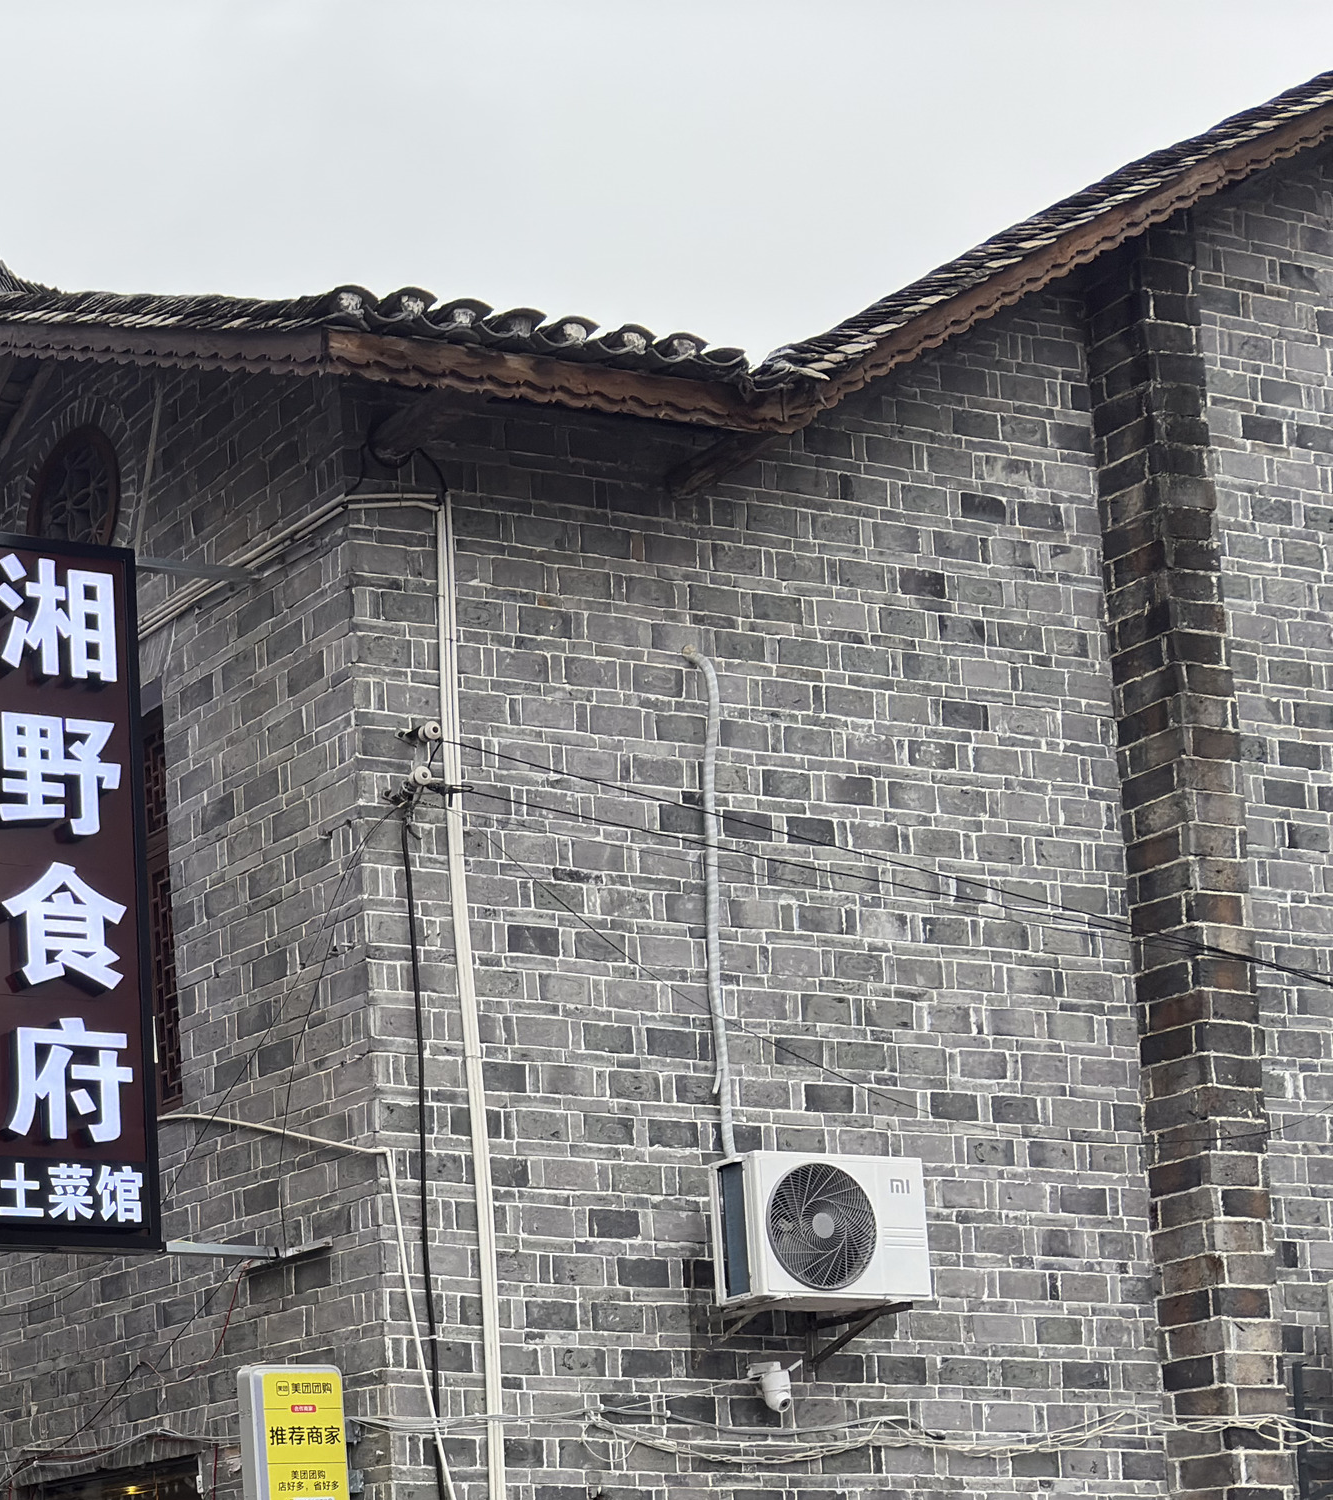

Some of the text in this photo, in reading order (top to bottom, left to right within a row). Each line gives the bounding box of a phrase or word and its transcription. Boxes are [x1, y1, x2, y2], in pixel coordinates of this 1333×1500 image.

[291, 1382, 333, 1394] 美团团购
[270, 1426, 341, 1445] 推荐商家
[291, 1470, 326, 1480] 美团团购
[278, 1481, 340, 1492] 店好多，省好多
